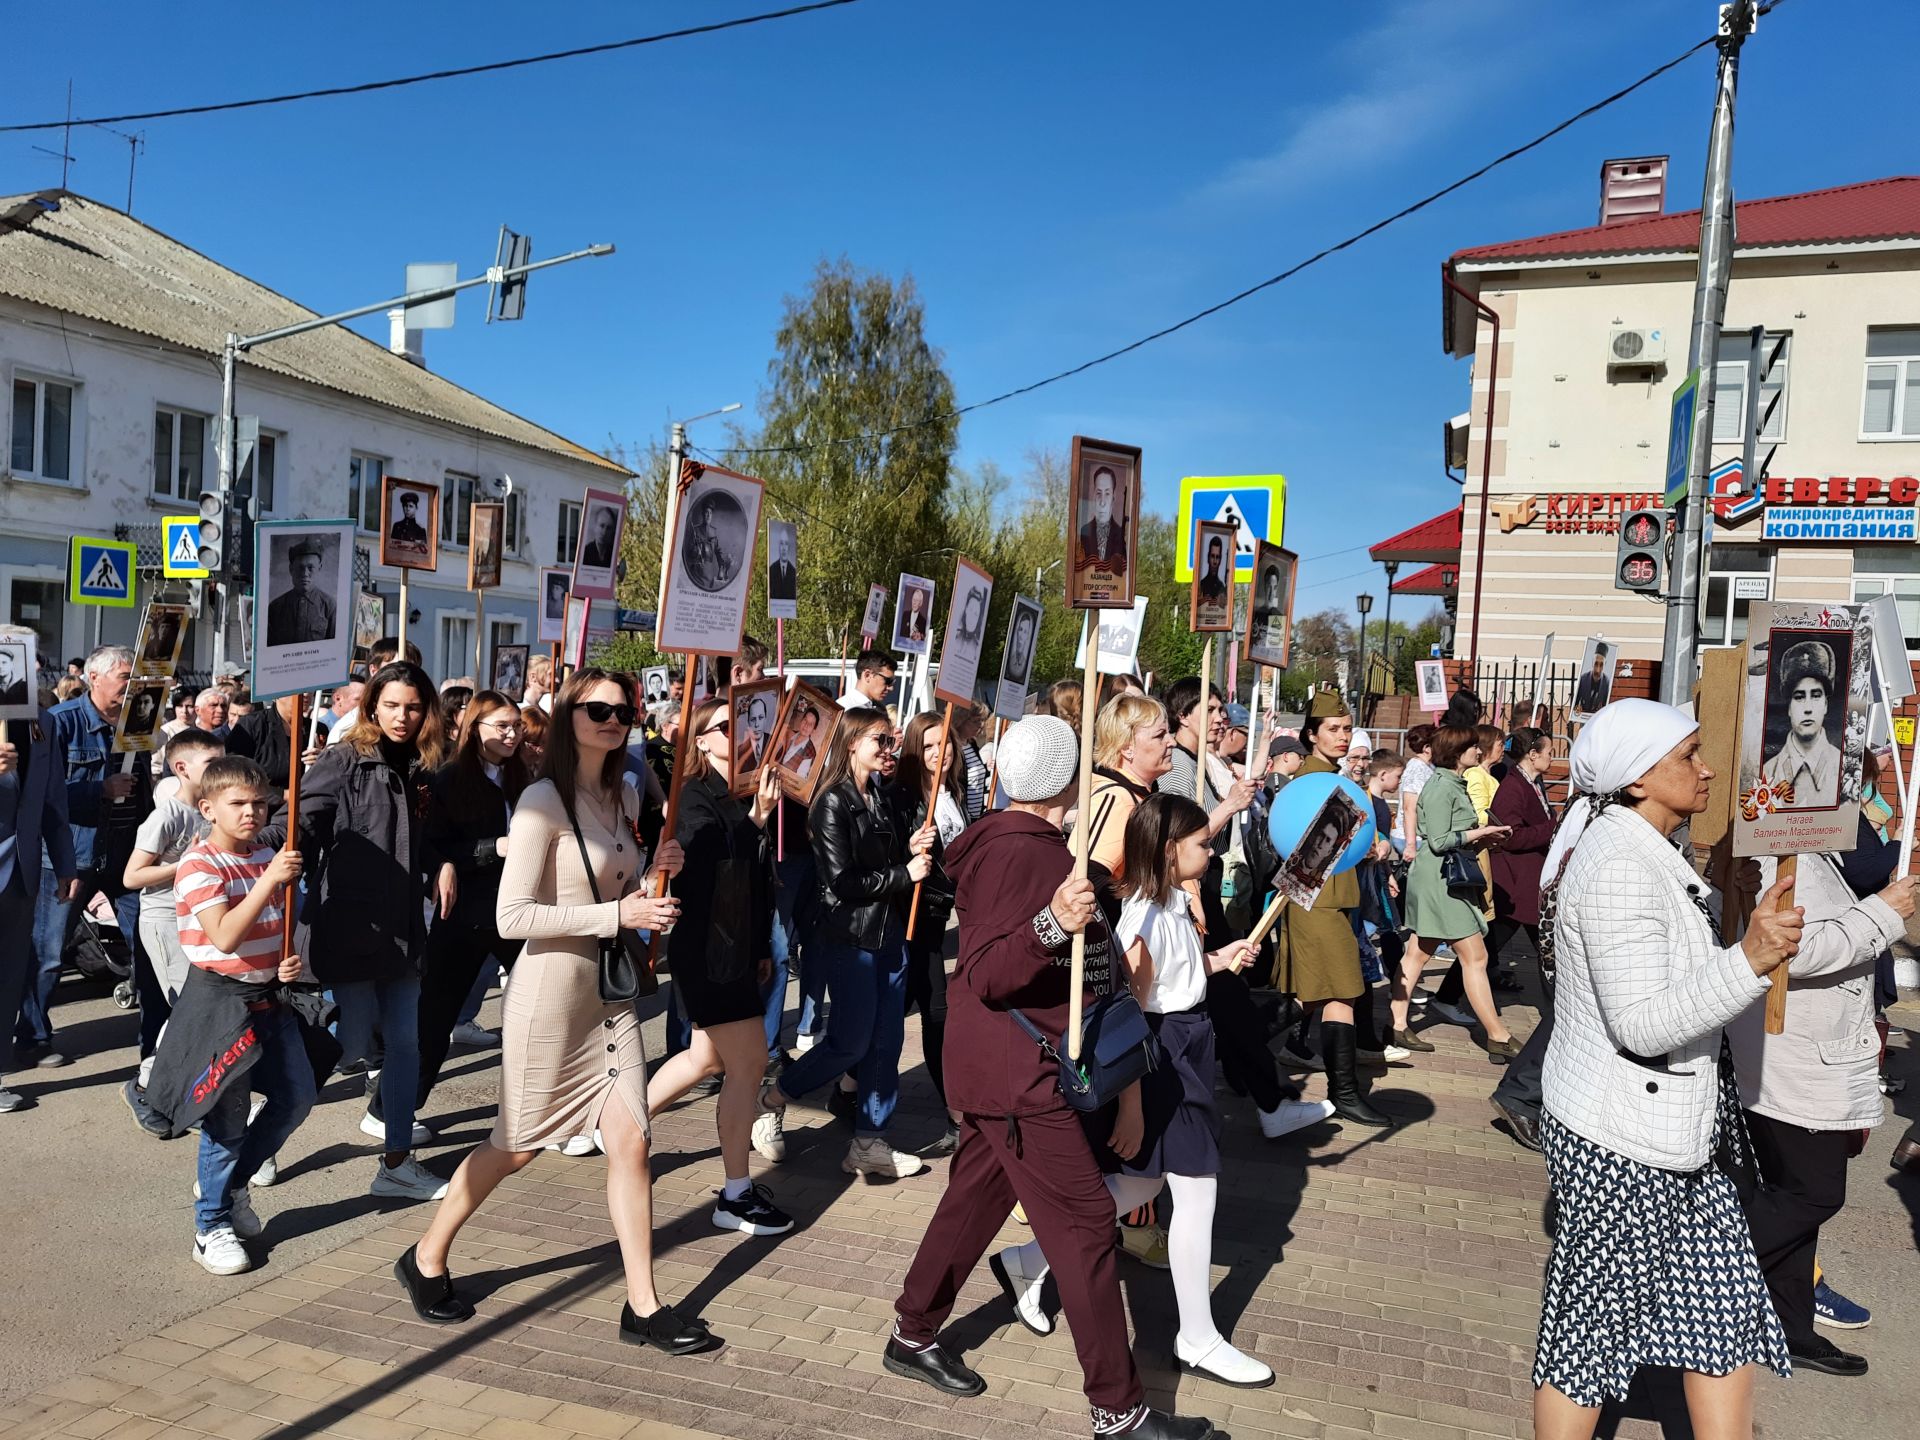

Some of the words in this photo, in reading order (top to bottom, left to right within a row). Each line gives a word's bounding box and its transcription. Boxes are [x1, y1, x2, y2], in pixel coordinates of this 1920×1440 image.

[1768, 509, 1915, 521] микрокредитная
[1546, 520, 1581, 534] ВСЕХ
[1786, 815, 1814, 824] Нагаев
[1789, 826, 1843, 837] Масалимович
[1093, 984, 1110, 996] YOU
[193, 1028, 257, 1104] Supreme
